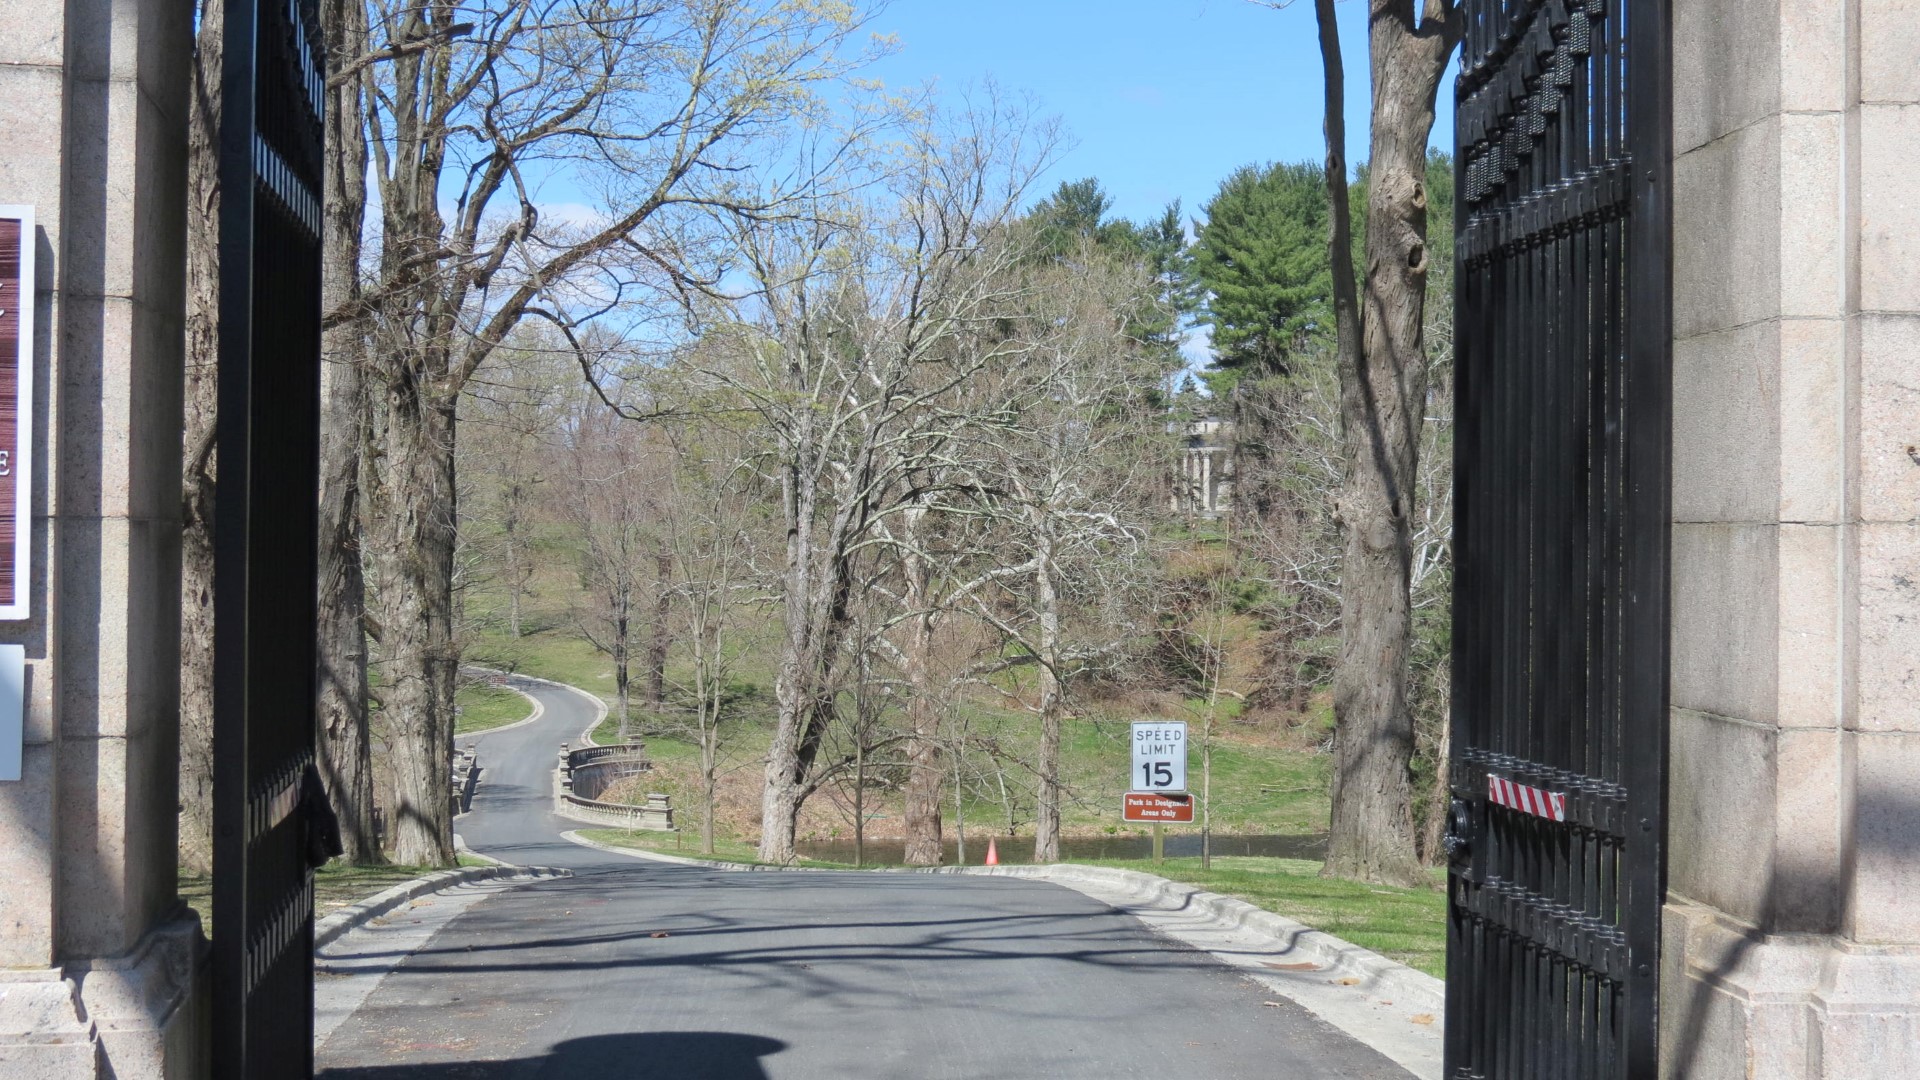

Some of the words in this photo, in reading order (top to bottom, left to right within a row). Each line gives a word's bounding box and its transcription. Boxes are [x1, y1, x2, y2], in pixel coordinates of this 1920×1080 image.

[1136, 730, 1182, 741] SPEED
[1141, 744, 1176, 755] LIMIT
[1142, 762, 1173, 787] 15
[1128, 798, 1143, 806] Park
[1161, 809, 1177, 818] Only
